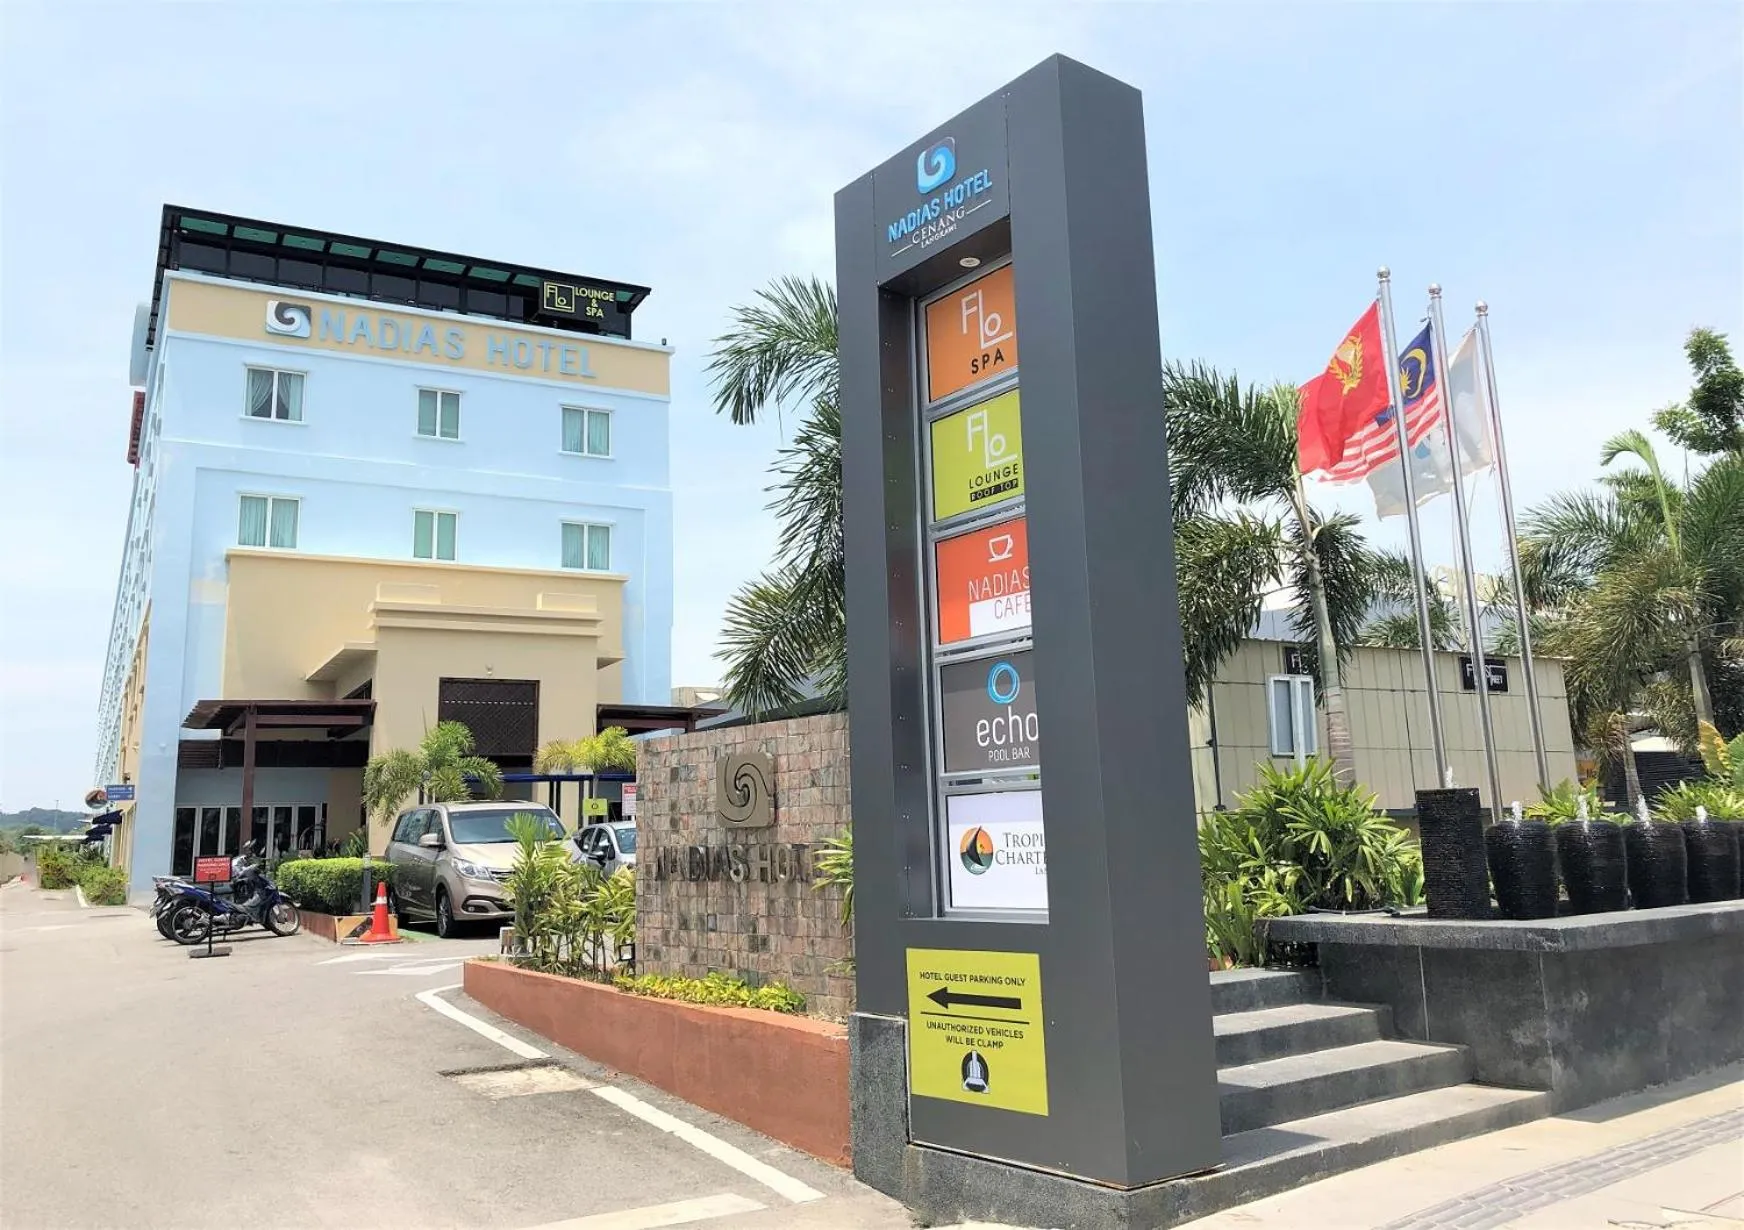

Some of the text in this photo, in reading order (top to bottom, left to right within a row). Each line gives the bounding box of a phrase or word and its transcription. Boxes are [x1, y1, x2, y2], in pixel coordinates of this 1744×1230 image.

[887, 169, 993, 243] NADIAS HOTEL
[912, 206, 967, 244] CENANG
[575, 286, 615, 302] LOUNGE
[591, 298, 598, 307] &
[586, 306, 604, 318] SPA
[318, 310, 597, 379] NADIAS HOTEL
[971, 347, 1005, 375] SPA
[969, 463, 1020, 489] LOUNGE
[970, 479, 1019, 502] ROOF TOP
[968, 566, 1030, 602] NADIAS
[994, 593, 1031, 620] CAFE
[976, 706, 1039, 747] echo
[988, 746, 1031, 762] POOL BAR
[919, 971, 1026, 987] HOTEL GUEST PARKING ONLY
[926, 1020, 1024, 1040] UNAUTHORIZED VEHICLES
[945, 1033, 1004, 1049] WILL BE CLAMP
